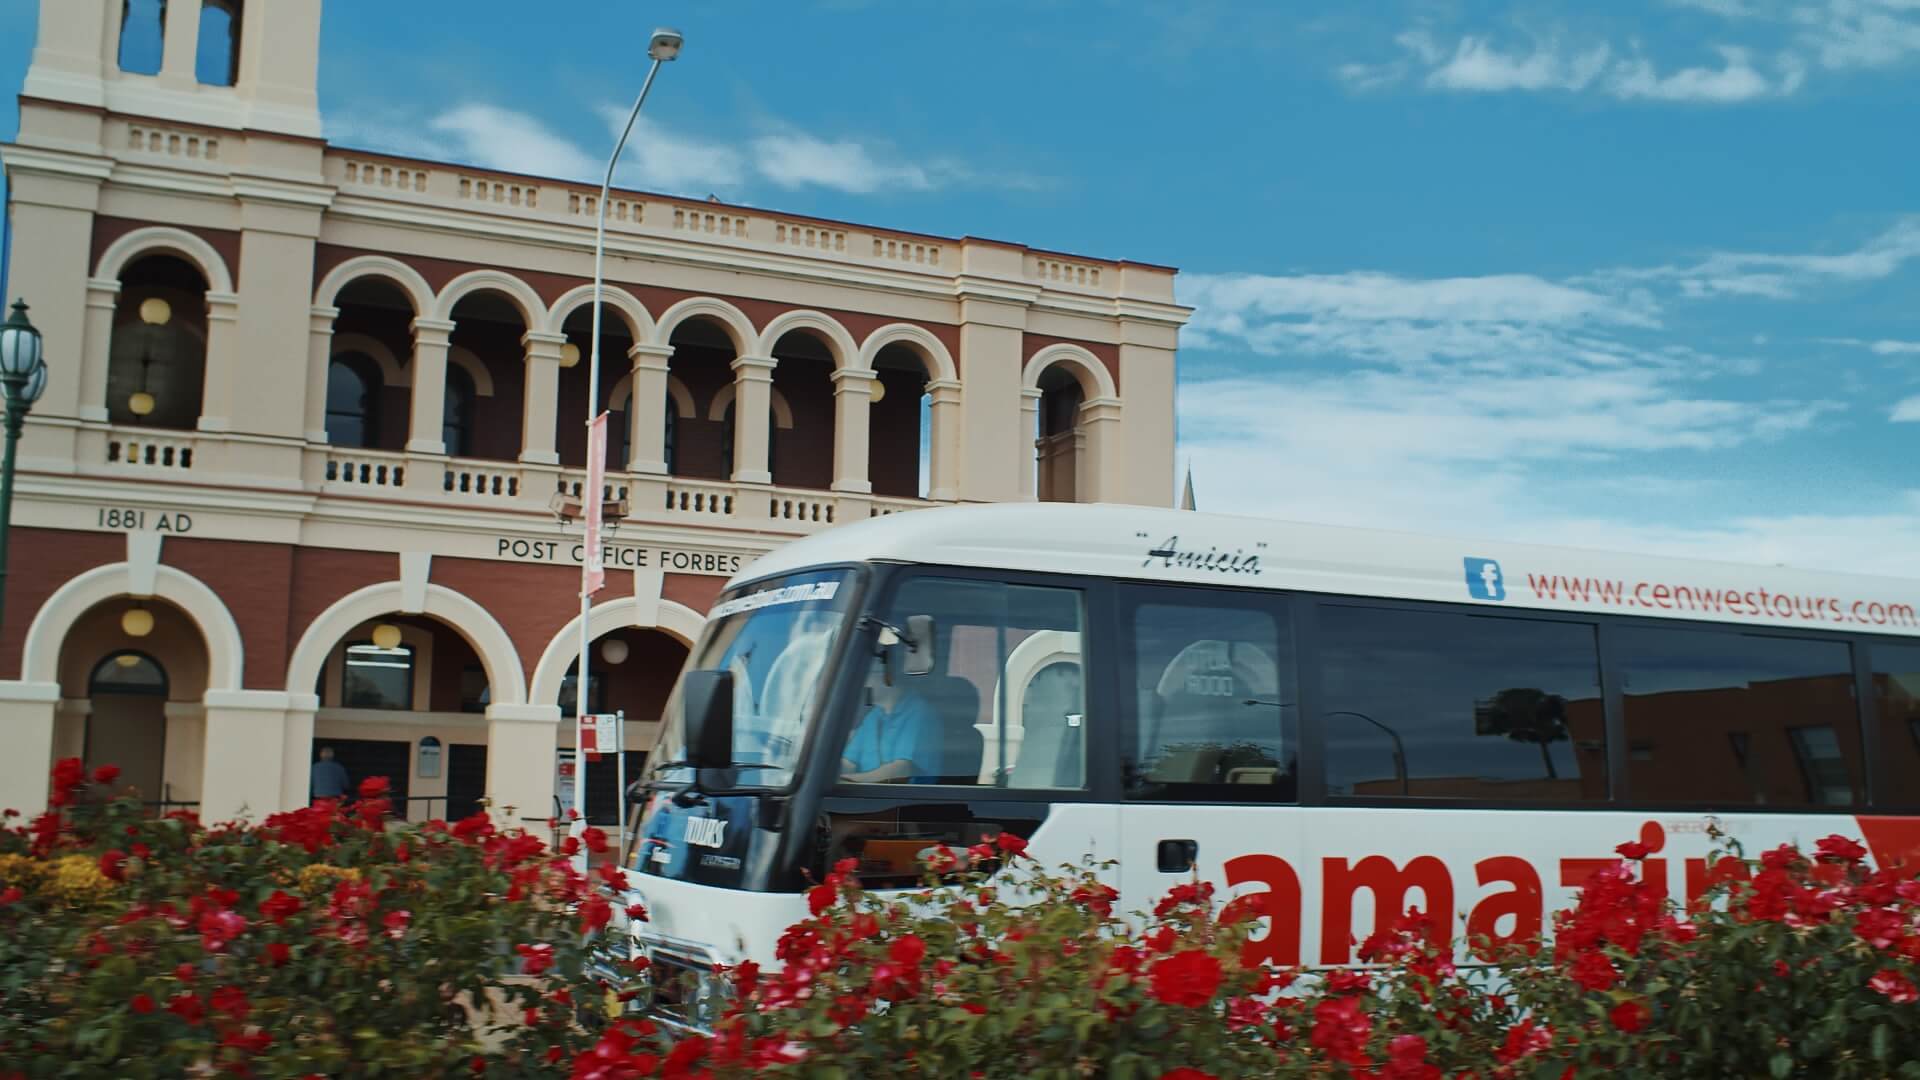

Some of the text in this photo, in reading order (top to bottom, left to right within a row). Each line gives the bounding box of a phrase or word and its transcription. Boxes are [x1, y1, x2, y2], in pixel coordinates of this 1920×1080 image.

[98, 509, 192, 533] 1881 AD
[498, 538, 741, 573] POST OFICE FORBES
[1527, 572, 1917, 626] www.cenwestours.com
